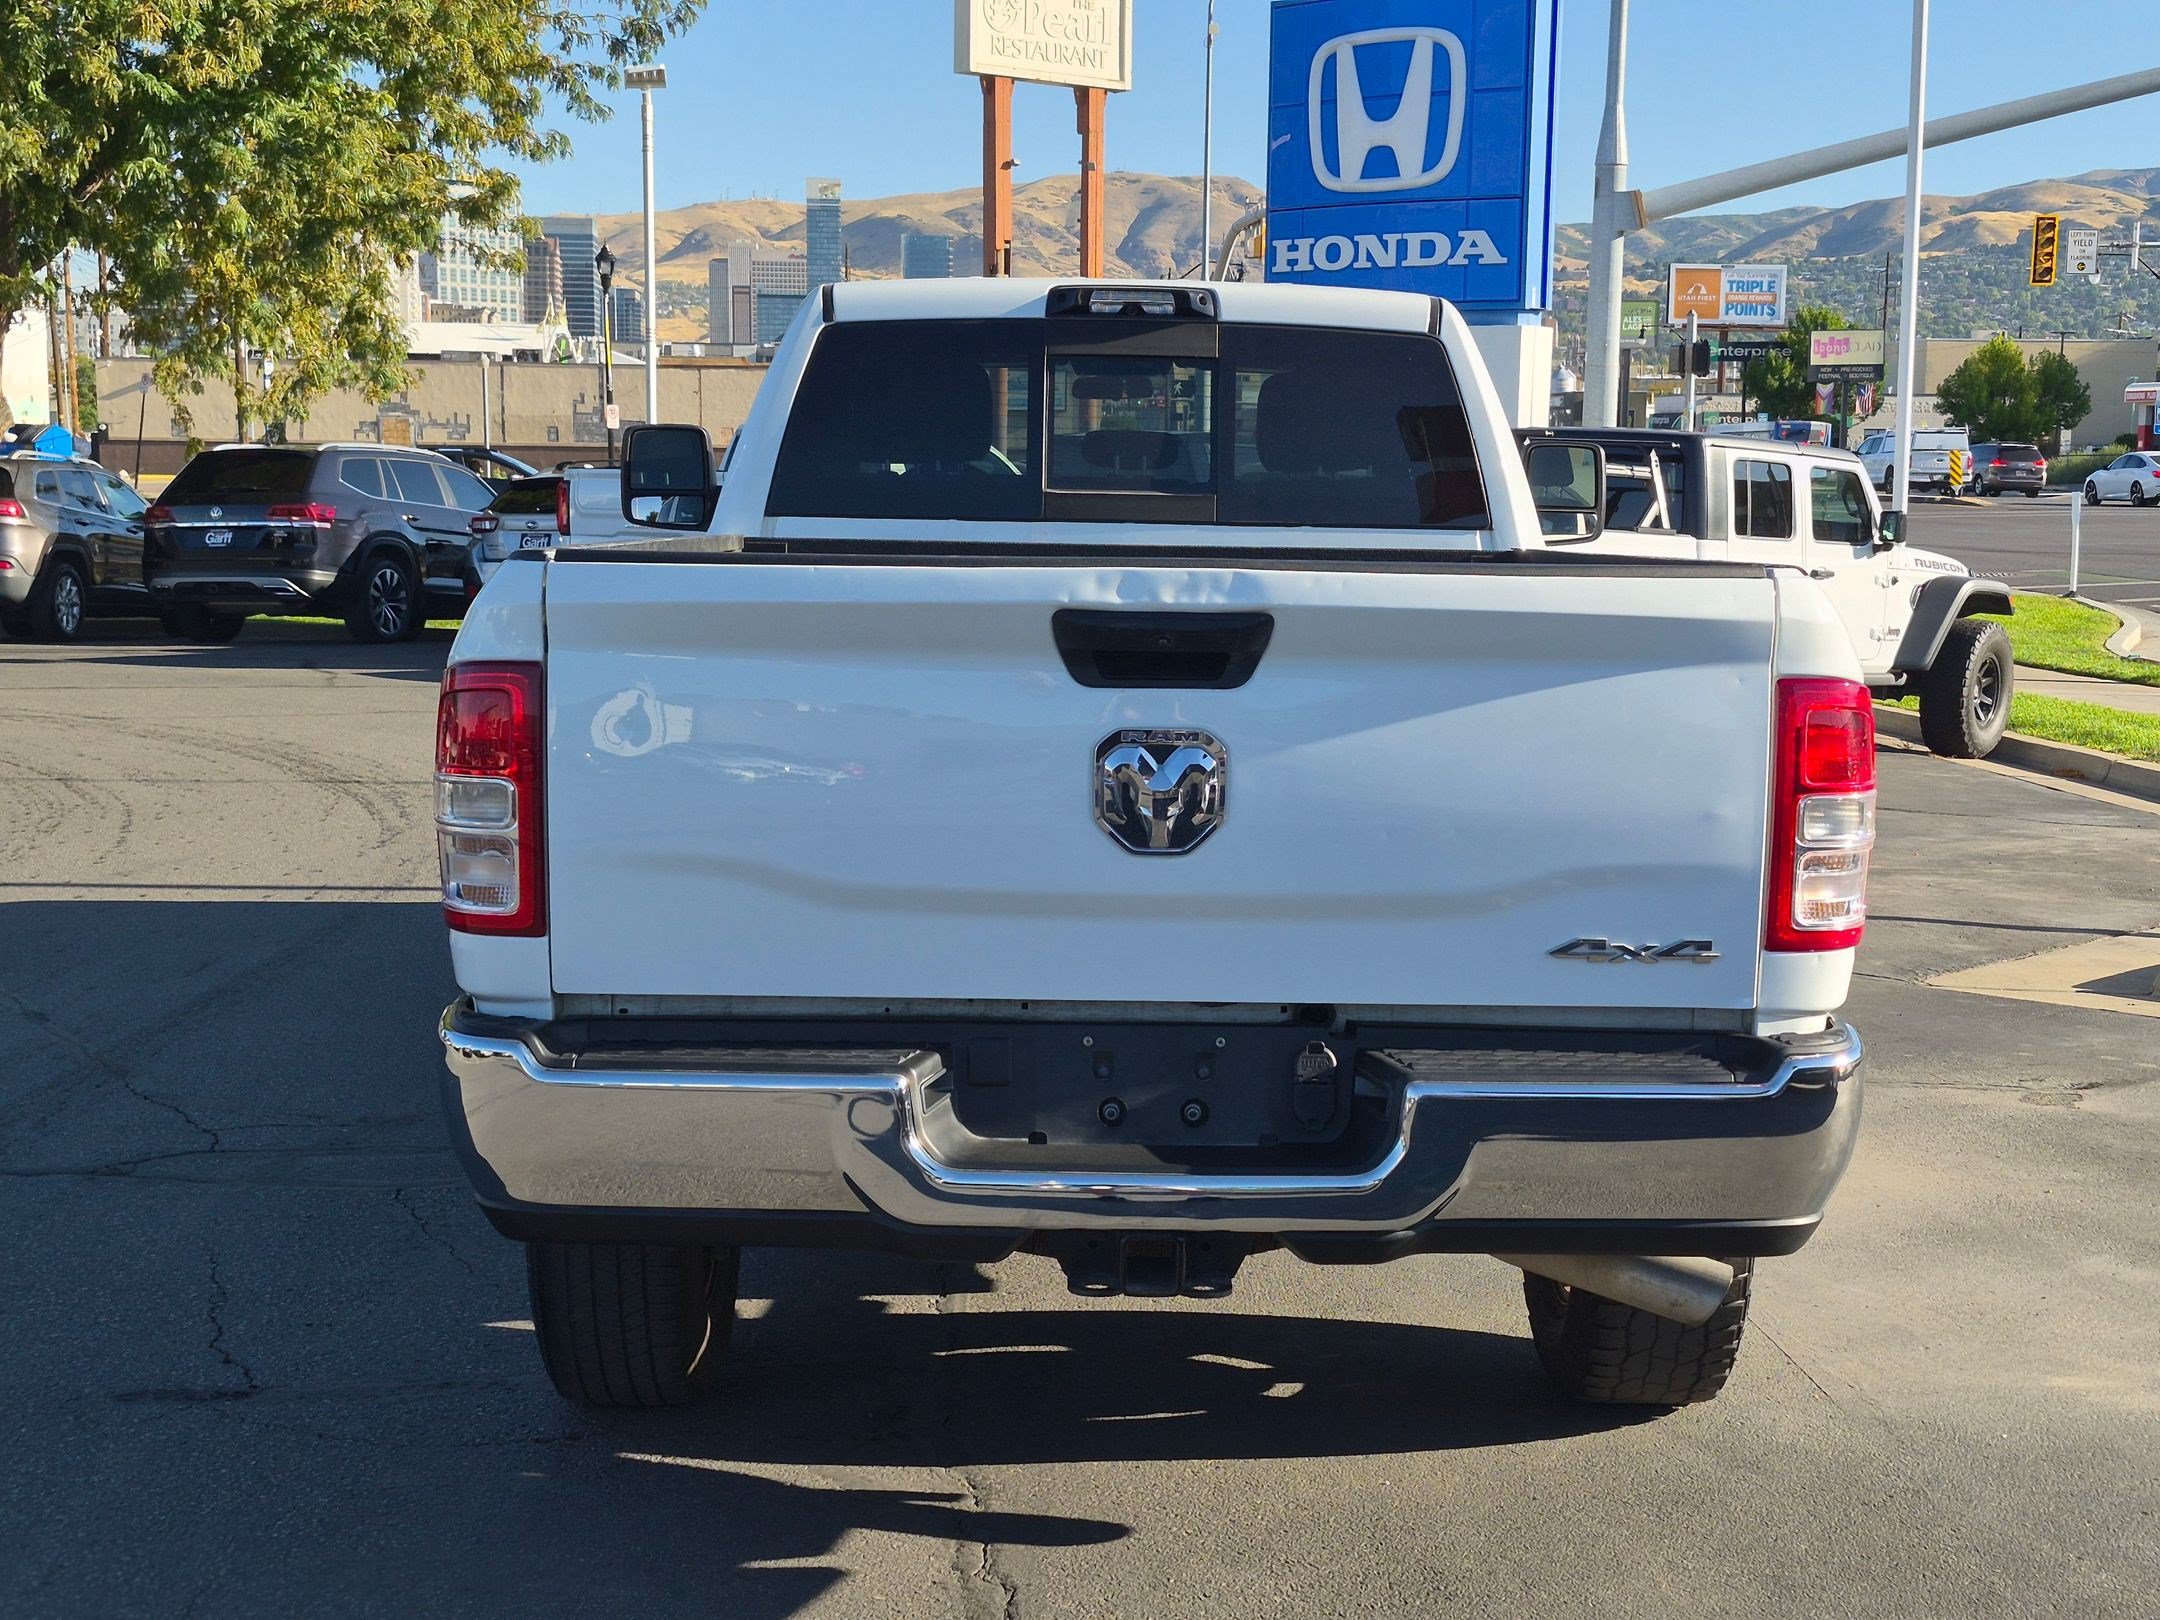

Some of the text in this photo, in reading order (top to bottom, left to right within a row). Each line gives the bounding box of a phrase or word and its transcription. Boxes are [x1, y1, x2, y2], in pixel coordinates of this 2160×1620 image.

[1022, 0, 1112, 46] Pearl
[990, 34, 1109, 70] RESTAURANT
[2073, 239, 2093, 247] YIELD
[1271, 230, 1508, 273] HONDA
[1726, 279, 1776, 293] TRIPLE
[1724, 303, 1776, 317] POINTS
[1709, 345, 1792, 358] enterprse
[205, 531, 233, 544] Garff
[521, 536, 549, 549] Garff
[1914, 558, 1965, 574] RUBICON
[1120, 730, 1200, 744] RAM
